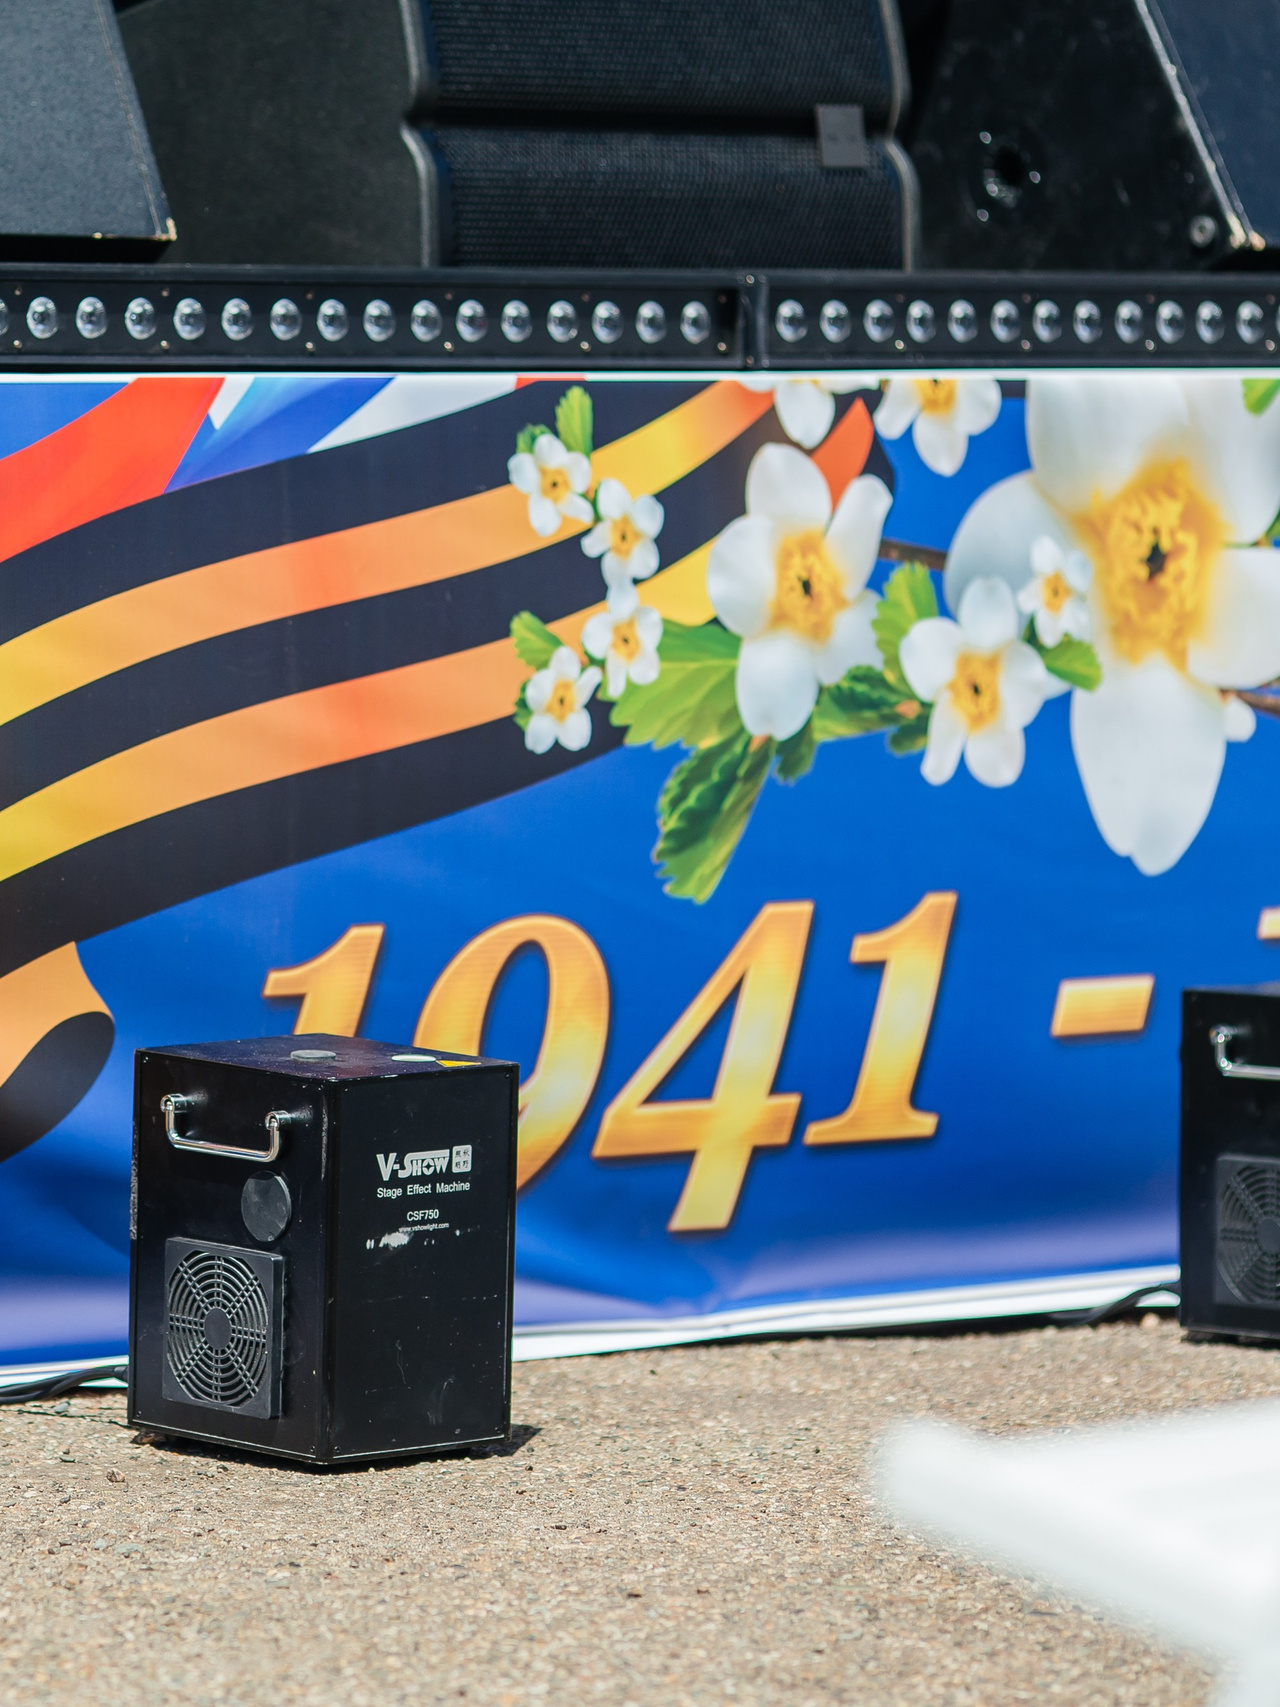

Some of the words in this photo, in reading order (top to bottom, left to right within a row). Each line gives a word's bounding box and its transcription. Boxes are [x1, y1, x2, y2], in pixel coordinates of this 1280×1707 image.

[376, 1187, 403, 1199] Stage
[406, 1183, 432, 1195] Effect
[436, 1180, 471, 1193] Machine
[406, 1208, 440, 1221] CSF750
